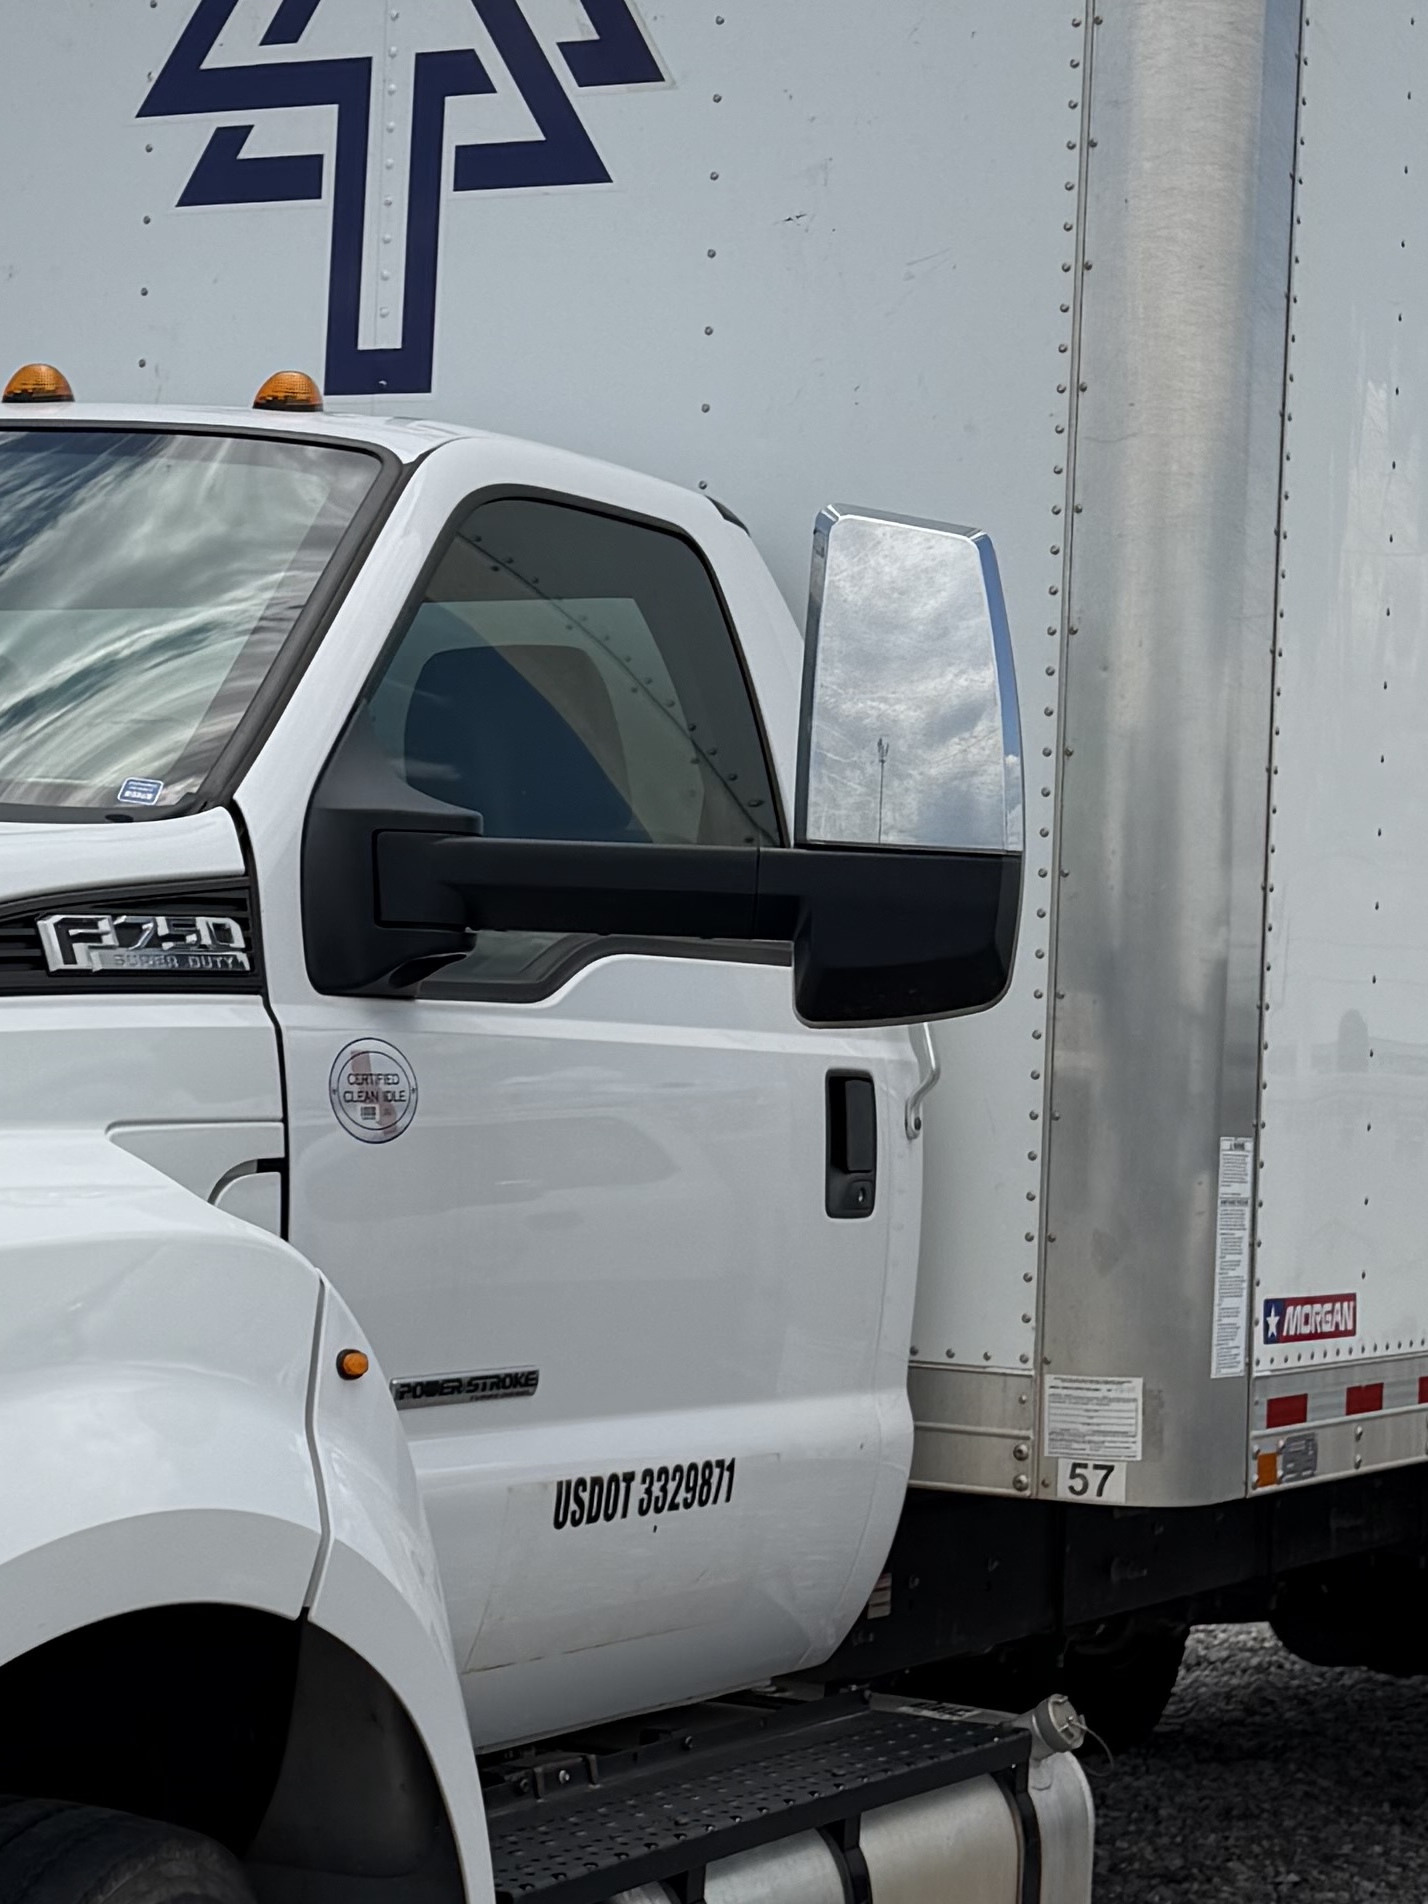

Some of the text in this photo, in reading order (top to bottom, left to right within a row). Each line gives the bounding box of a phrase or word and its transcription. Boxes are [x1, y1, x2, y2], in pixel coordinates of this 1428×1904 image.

[113, 954, 235, 969] SUPER DUTY
[347, 1073, 400, 1086] CERTIFIED
[343, 1090, 407, 1103] CLEAN IDLE
[1283, 1301, 1354, 1336] MORGAN
[465, 1369, 539, 1396] STROKE
[1068, 1462, 1115, 1497] 57
[553, 1458, 736, 1530] USDOT 3329871
